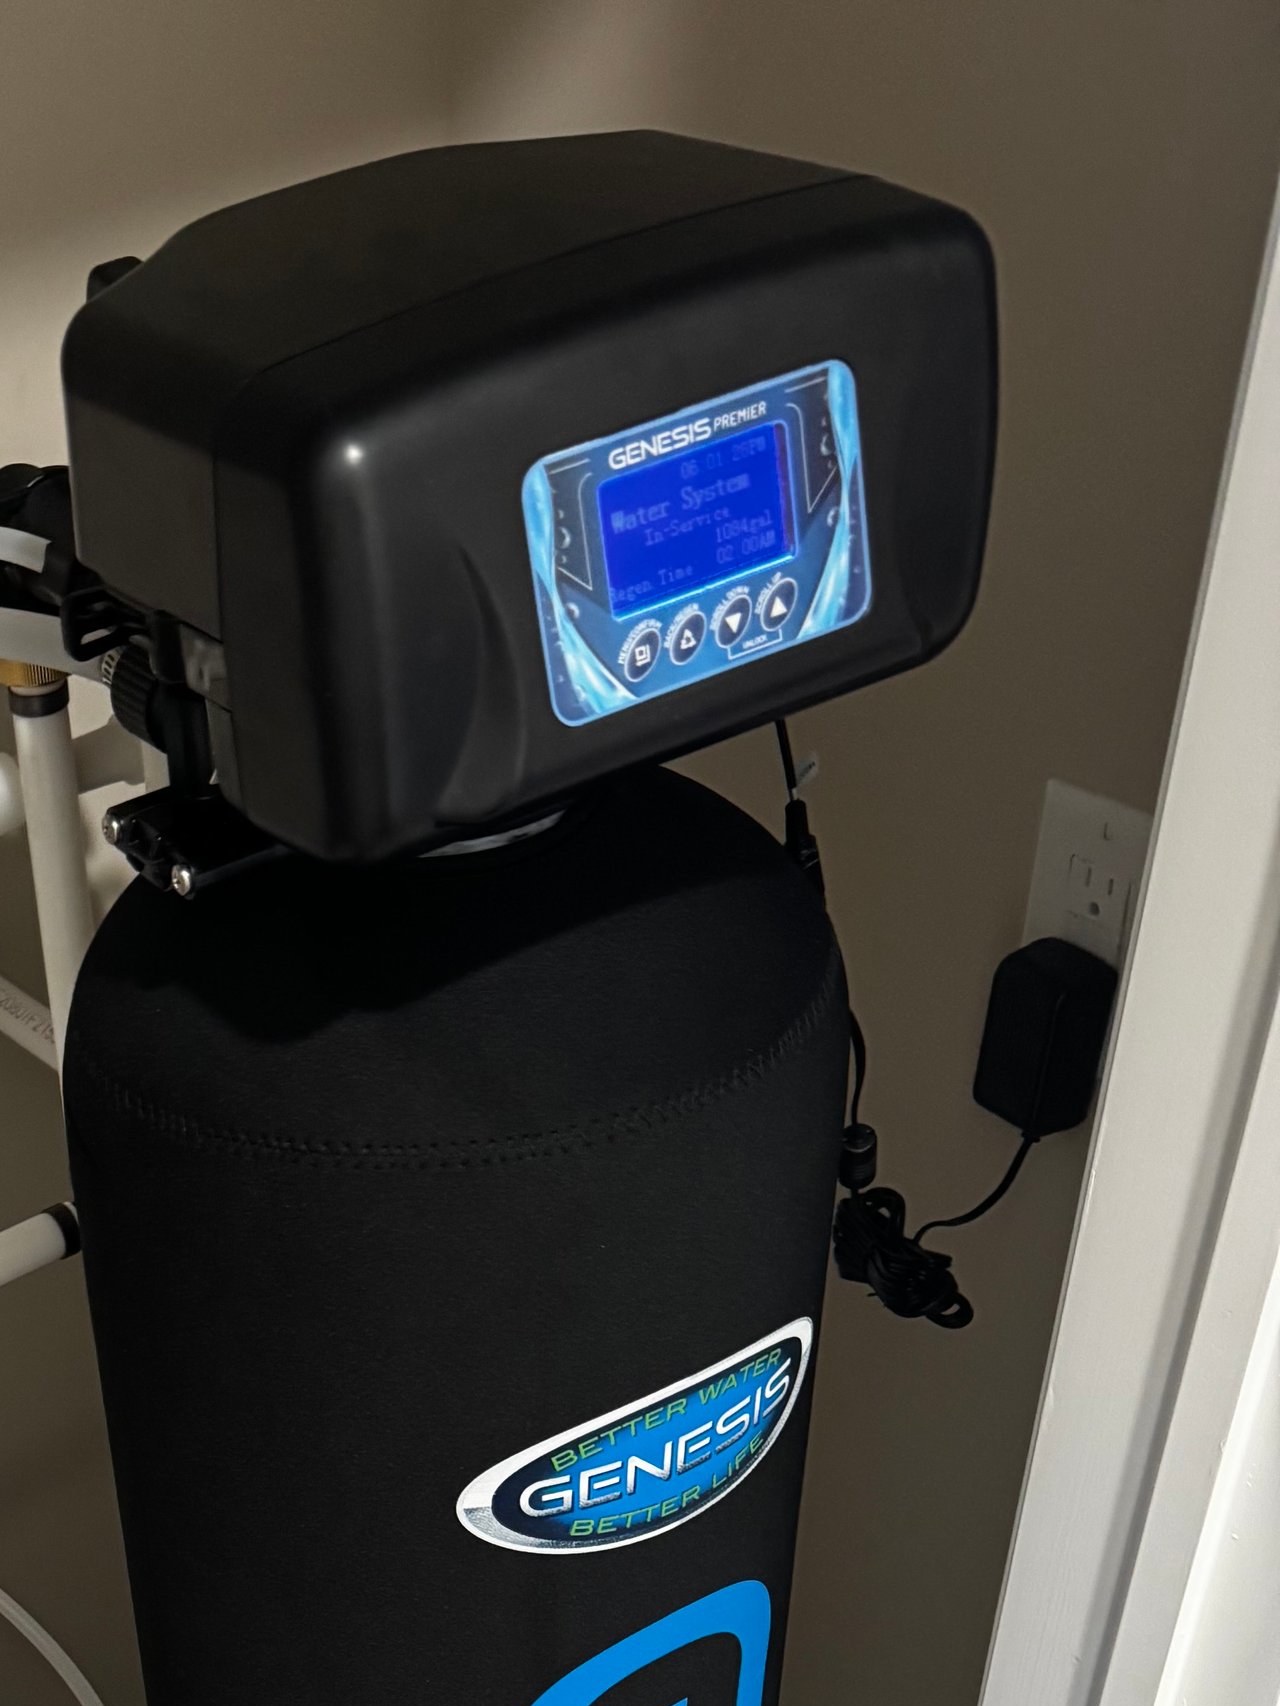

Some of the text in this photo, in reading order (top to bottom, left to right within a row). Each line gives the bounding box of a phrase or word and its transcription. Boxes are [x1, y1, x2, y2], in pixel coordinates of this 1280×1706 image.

[609, 401, 766, 469] GENESIS PREMIER
[680, 473, 750, 510] System
[520, 1358, 791, 1517] GENESIS
[551, 1349, 781, 1471] BETTER WATER
[570, 1430, 763, 1536] BETTER LIFE
